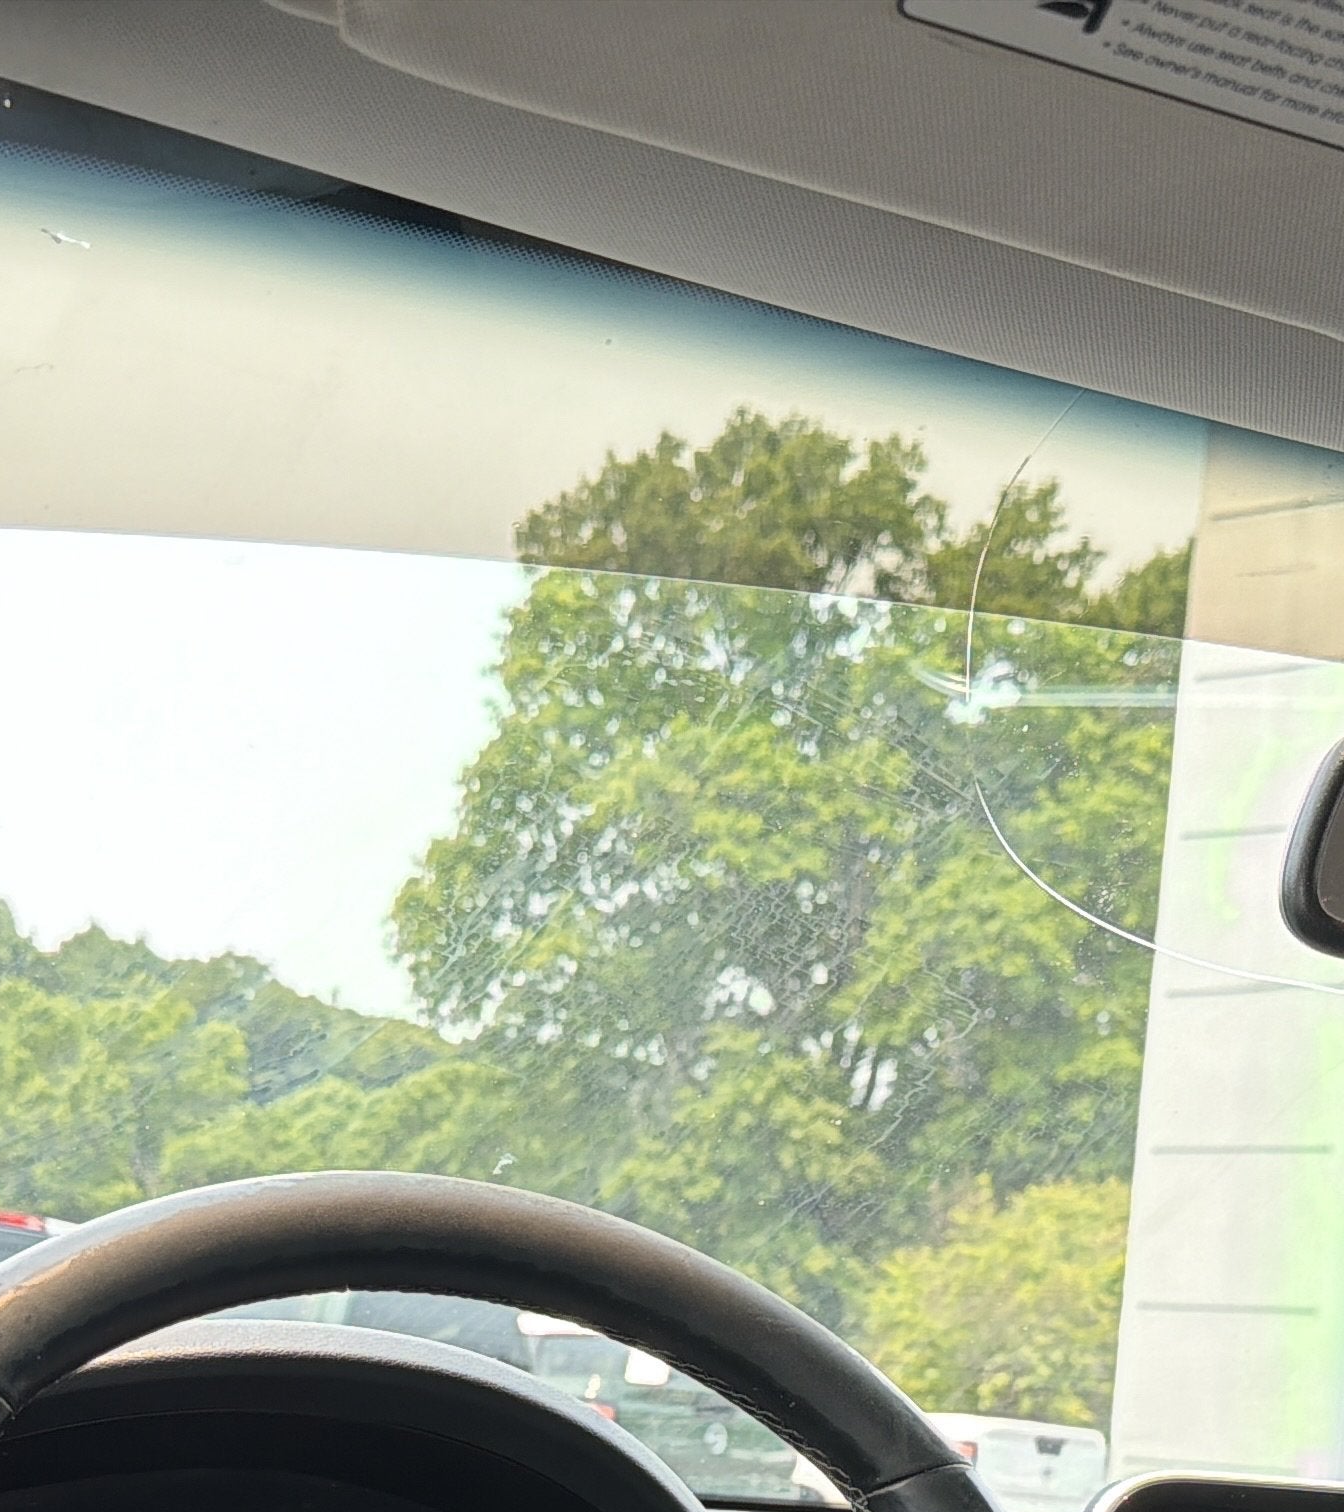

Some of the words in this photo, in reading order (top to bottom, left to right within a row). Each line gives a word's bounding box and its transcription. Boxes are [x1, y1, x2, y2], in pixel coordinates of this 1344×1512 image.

[1294, 17, 1320, 35] the
[1113, 42, 1144, 61] See
[1288, 72, 1322, 90] and
